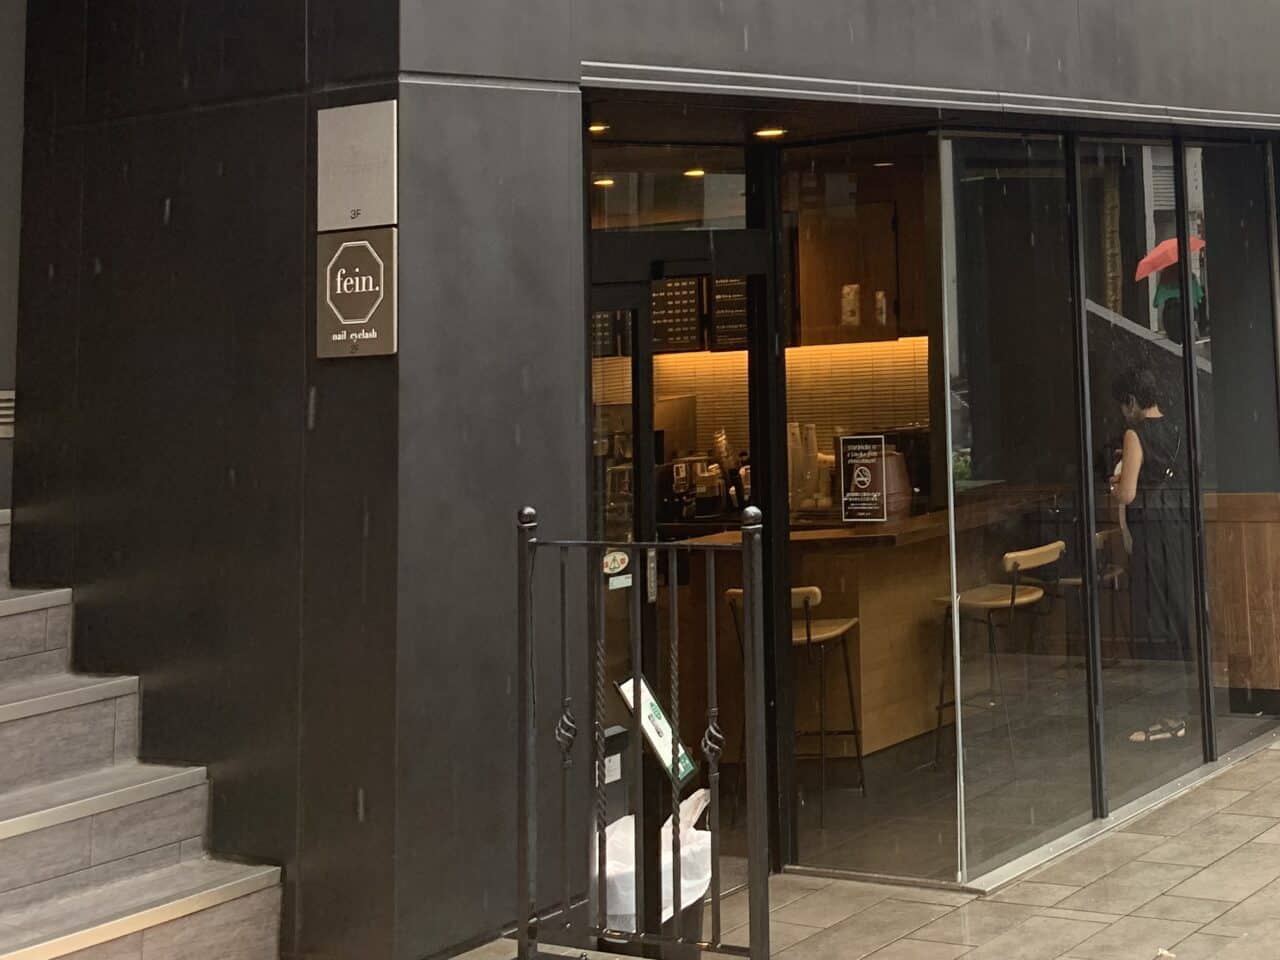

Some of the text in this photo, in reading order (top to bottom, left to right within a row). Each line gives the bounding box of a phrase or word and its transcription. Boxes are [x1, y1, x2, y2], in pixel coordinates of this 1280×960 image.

[335, 267, 380, 294] fein.
[332, 328, 378, 343] nail eyelash
